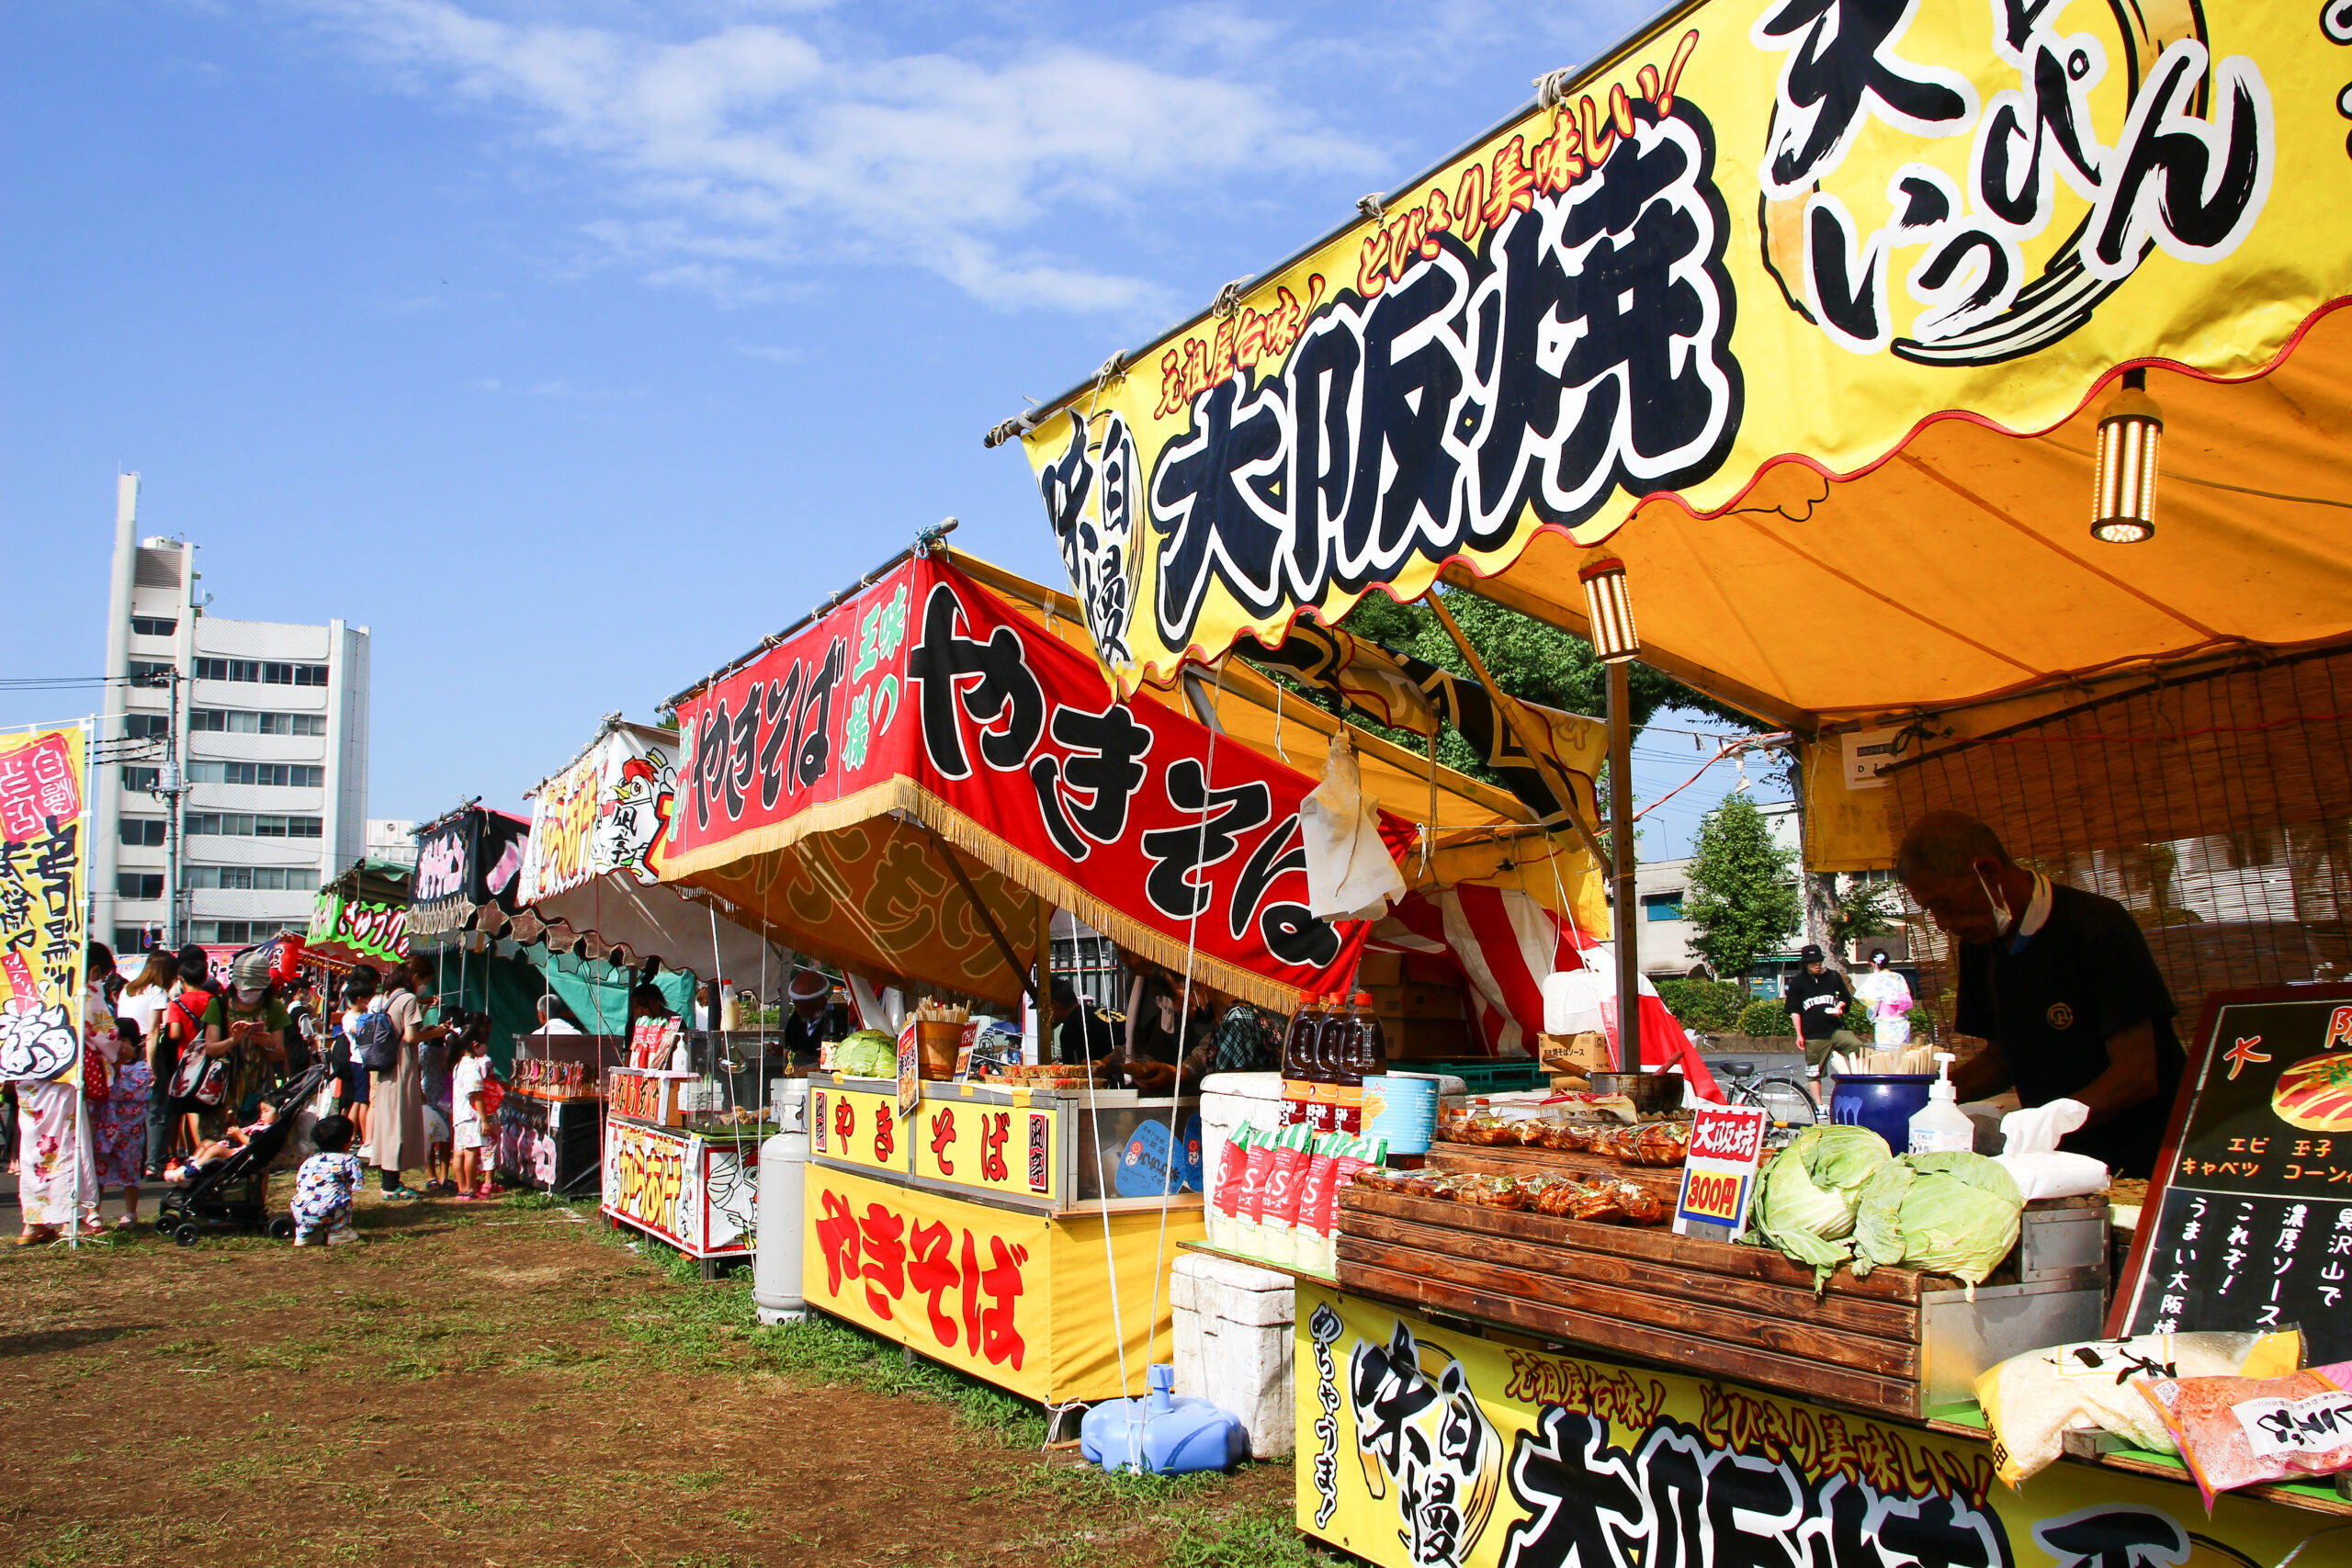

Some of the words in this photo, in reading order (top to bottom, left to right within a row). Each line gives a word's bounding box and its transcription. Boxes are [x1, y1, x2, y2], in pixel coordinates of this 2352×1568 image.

[1148, 96, 1745, 653] 大阪焼
[1153, 273, 1326, 420] 元祖屋台味!
[694, 634, 848, 831] やきそば
[835, 1095, 1010, 1182] やきそば
[1696, 1111, 1760, 1158] 大阪焼
[2181, 1157, 2260, 1178] キャベツ
[2283, 1164, 2352, 1184] コーン
[2227, 1137, 2269, 1154] エビ
[2291, 1139, 2332, 1158] 玉子
[1687, 1174, 1739, 1217] 300円
[816, 1188, 1029, 1371] やきそば
[2153, 1196, 2209, 1335] うまい大阪焼
[2218, 1201, 2256, 1295] これぞ!
[2256, 1203, 2308, 1333] 濃厚ソース
[2317, 1208, 2352, 1308] 具沢山で
[1504, 1348, 1667, 1430] 元祖屋台味!
